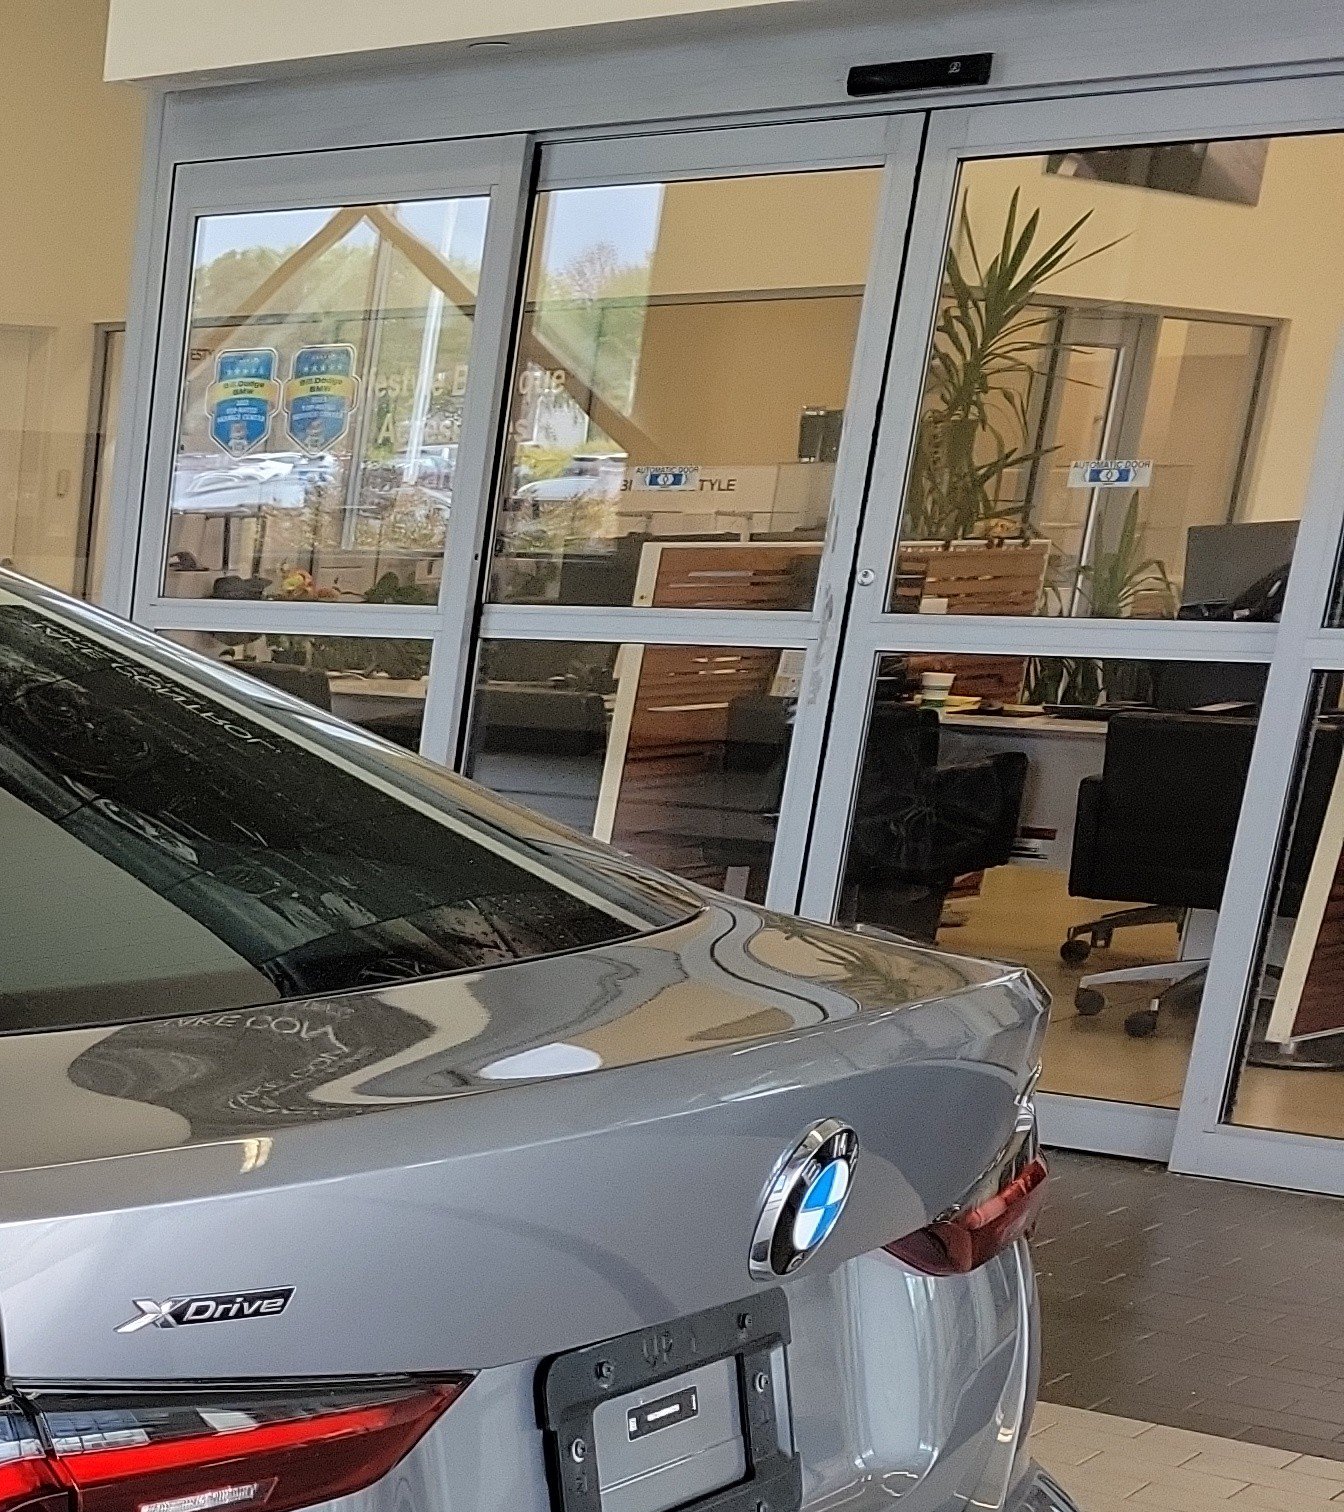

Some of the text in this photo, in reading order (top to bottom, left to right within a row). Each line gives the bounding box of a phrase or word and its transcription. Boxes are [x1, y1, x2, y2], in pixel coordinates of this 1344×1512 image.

[1072, 460, 1151, 469] AUTOMATIC DOOR
[678, 466, 699, 474] DOOR
